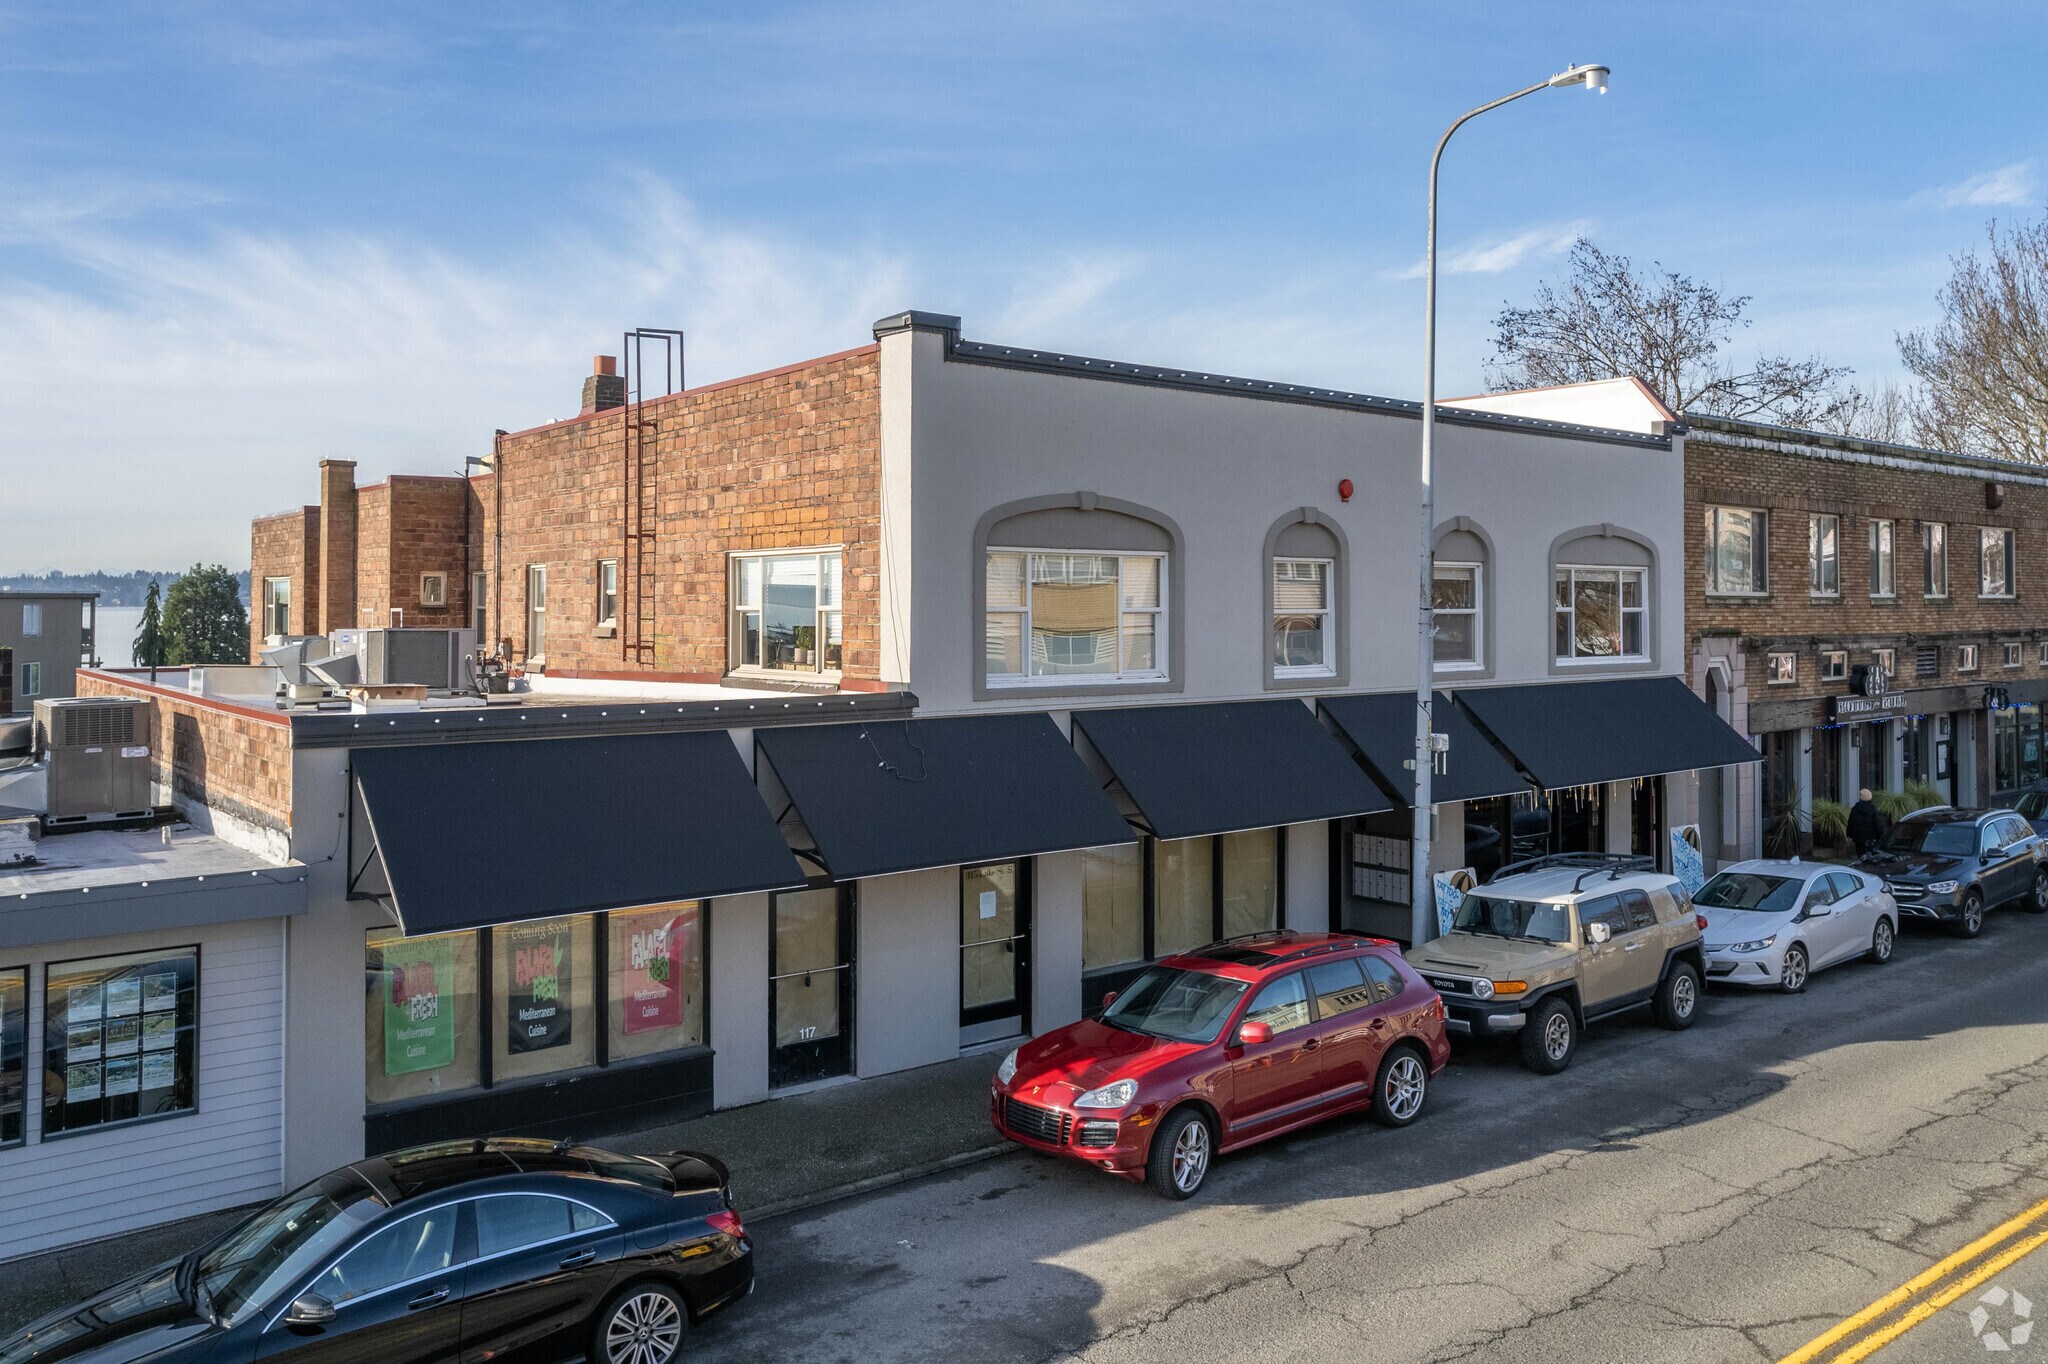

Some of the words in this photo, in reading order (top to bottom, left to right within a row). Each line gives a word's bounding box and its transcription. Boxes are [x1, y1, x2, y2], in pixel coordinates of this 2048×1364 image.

[1436, 879, 1457, 899] TATTOO
[511, 924, 546, 940] Coming
[548, 922, 569, 935] Soon
[387, 941, 424, 955] Coming
[631, 928, 670, 970] FALAFEL
[515, 944, 558, 988] FALAFEL
[647, 957, 670, 984] FRESH
[533, 974, 558, 1003] FRESH
[1434, 980, 1455, 988] TOYOTA
[634, 988, 668, 1003] Mediterranean
[411, 992, 438, 1022] FRESH
[519, 1007, 556, 1022] Mediterranean
[642, 1005, 659, 1018] Cuisine
[396, 1027, 436, 1041] Mediterranean
[528, 1024, 548, 1038] Cuisine
[800, 1026, 816, 1040] 117
[406, 1044, 427, 1058] Cuisine
